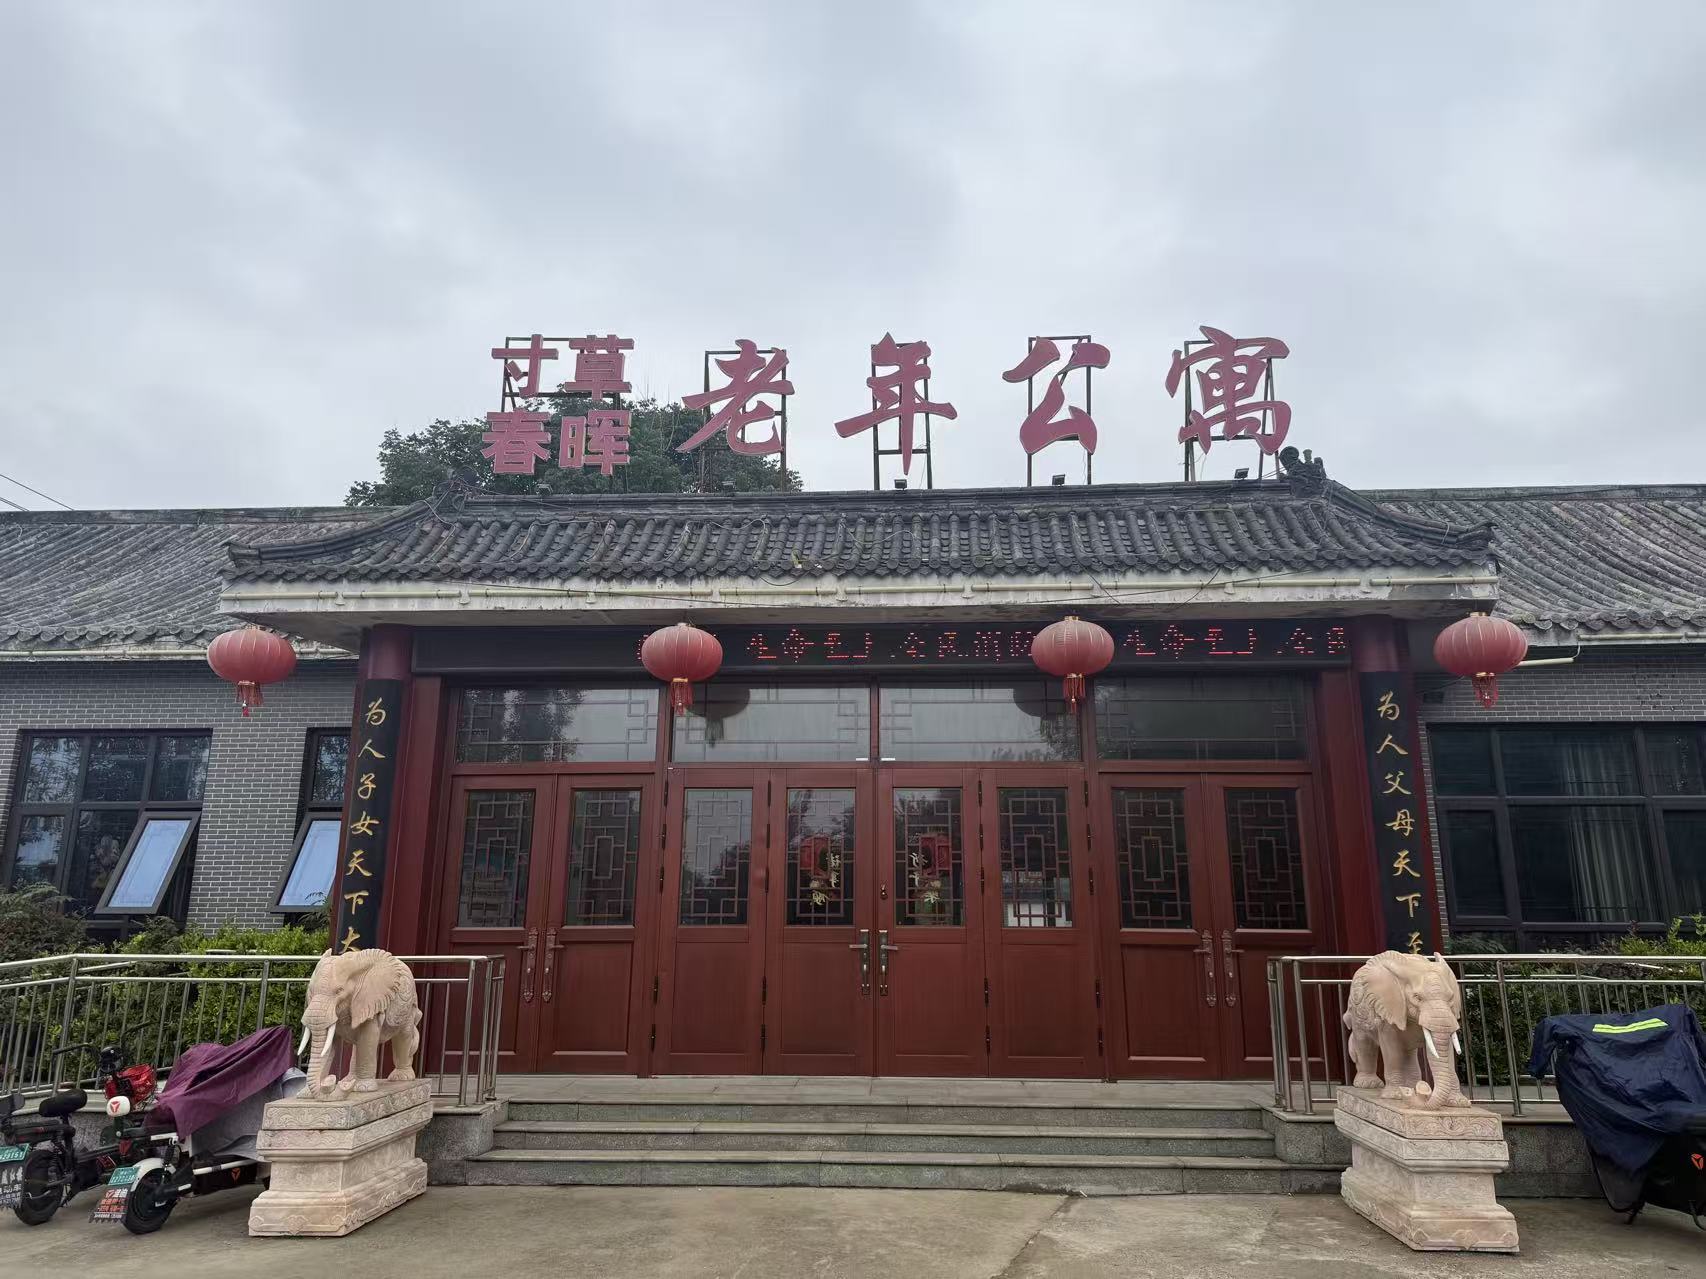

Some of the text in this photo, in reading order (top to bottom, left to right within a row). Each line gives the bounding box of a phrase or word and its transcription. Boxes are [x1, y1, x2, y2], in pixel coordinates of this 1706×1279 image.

[491, 333, 635, 401] 寸草
[674, 325, 1292, 476] 老年公寓
[480, 407, 633, 475] 春晖
